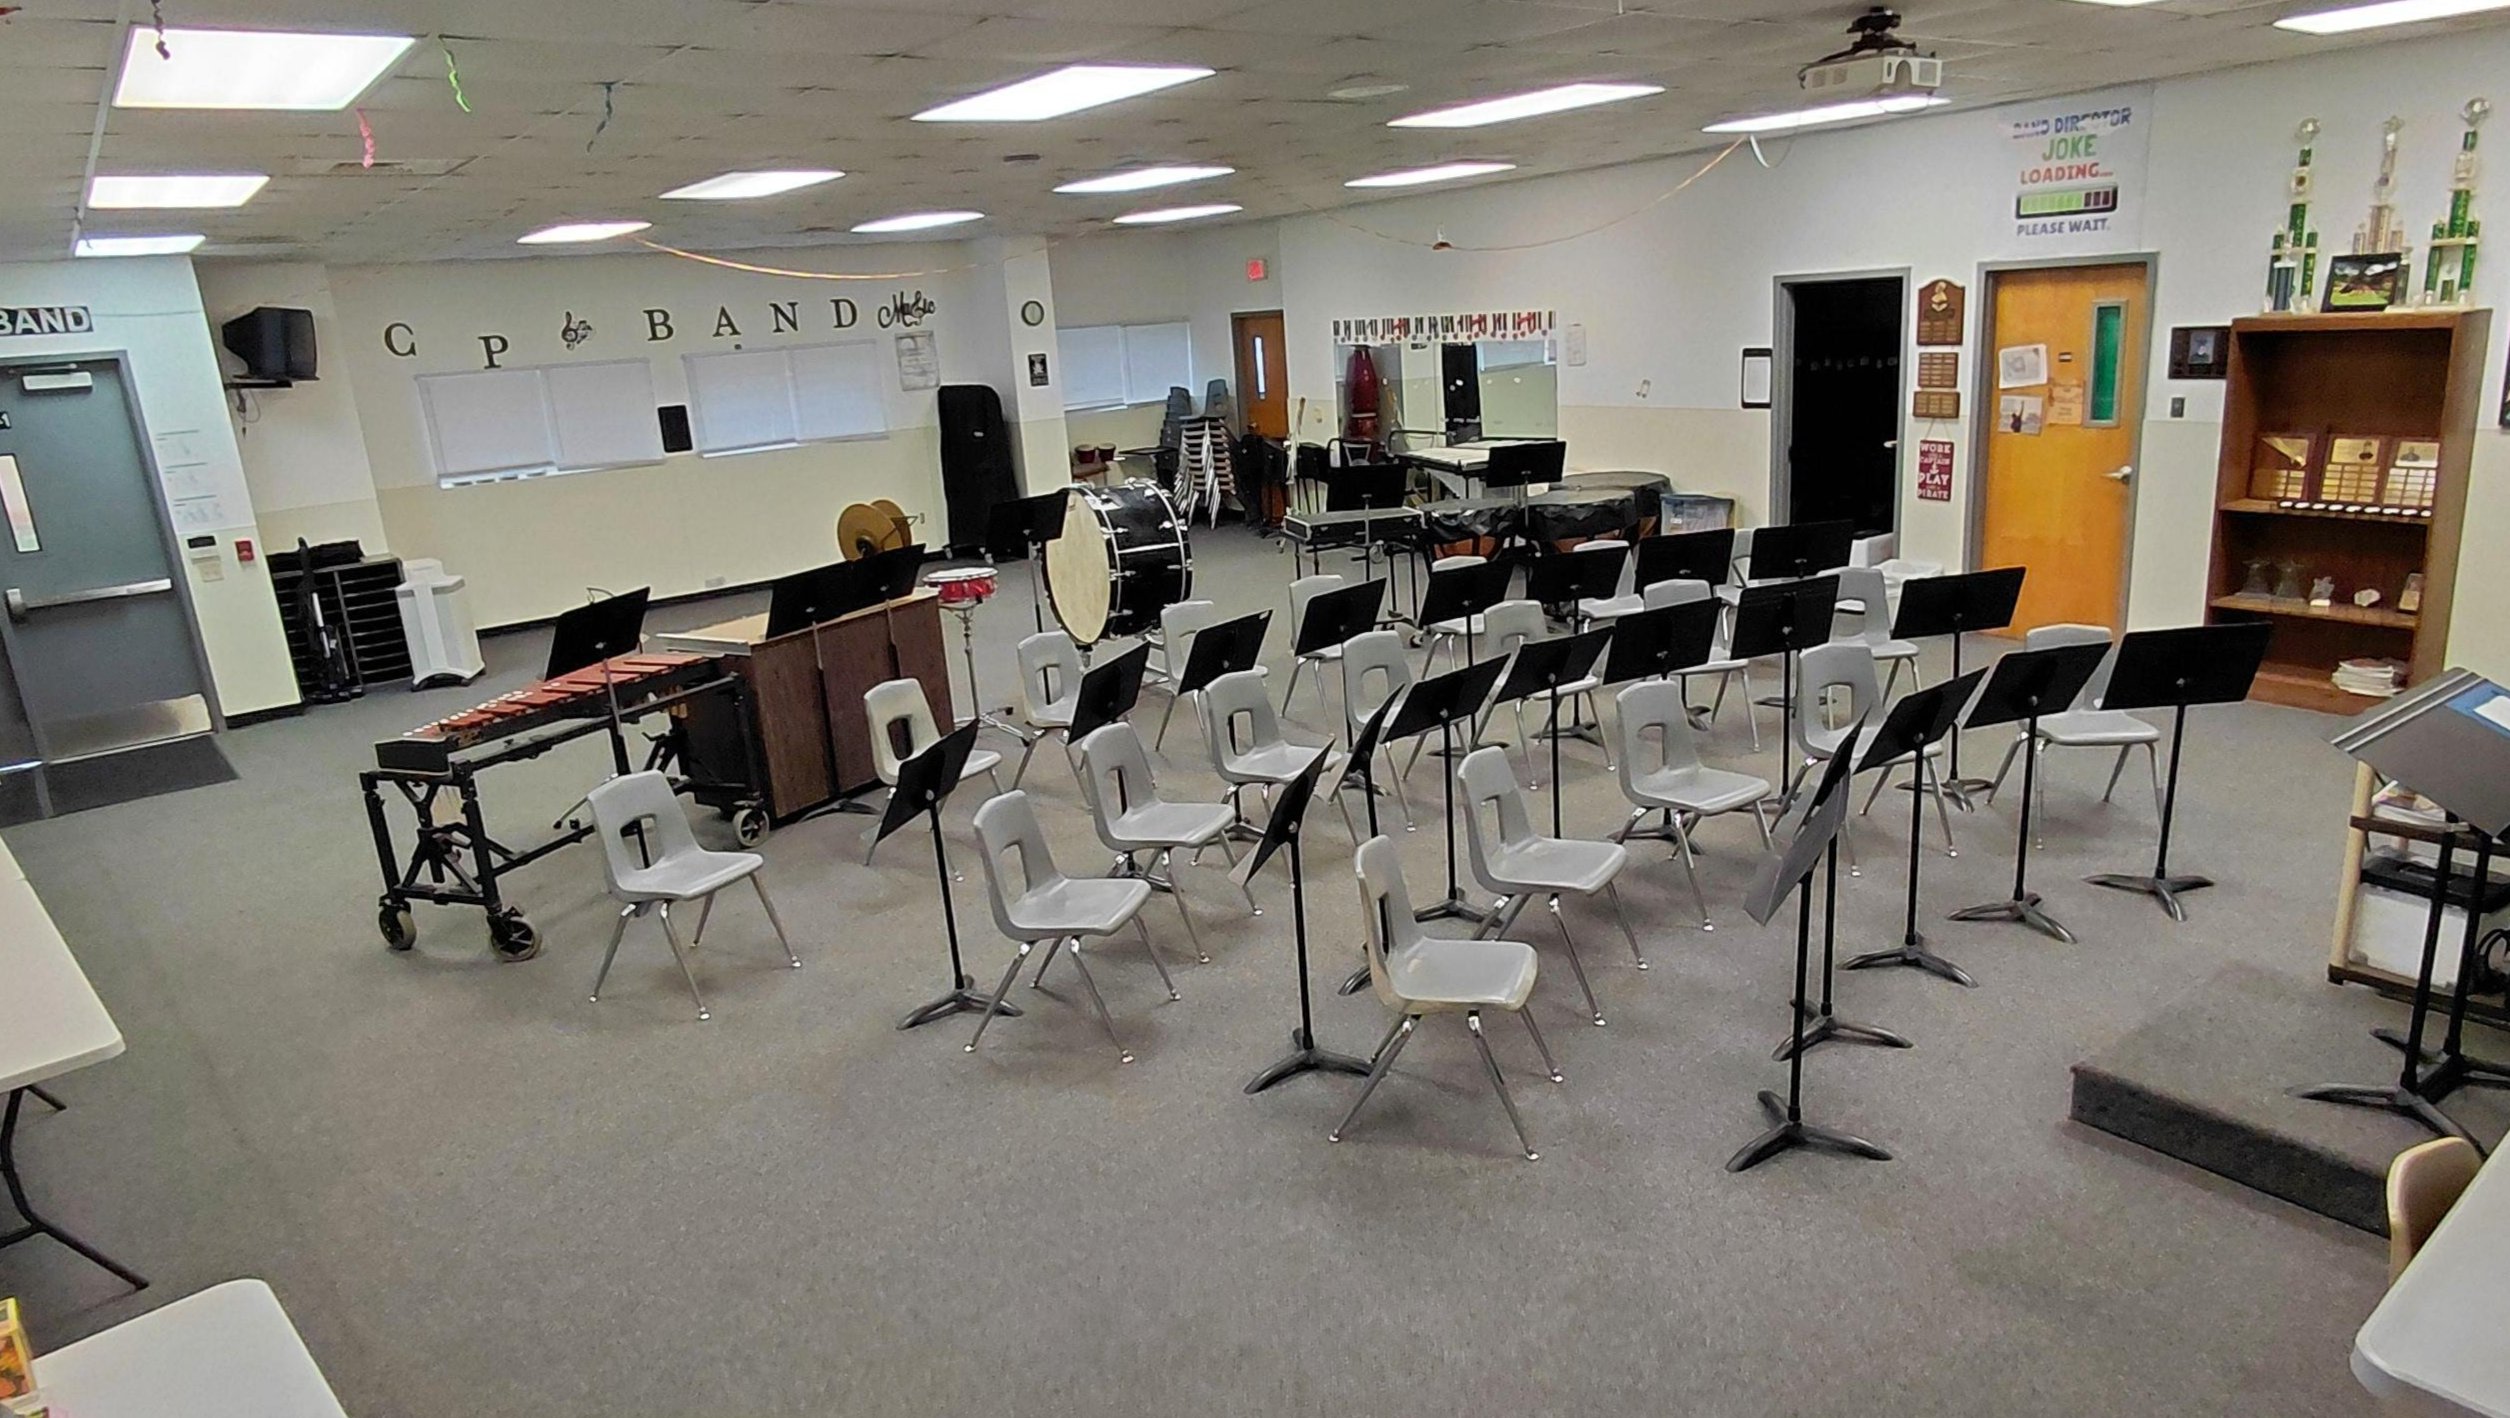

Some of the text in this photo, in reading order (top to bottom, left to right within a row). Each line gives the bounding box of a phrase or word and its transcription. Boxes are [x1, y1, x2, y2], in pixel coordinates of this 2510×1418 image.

[2042, 134, 2098, 161] JOKE
[2017, 221, 2065, 237] PLEASE
[478, 335, 509, 369] P
[1920, 442, 1951, 454] WORK
[1918, 472, 1950, 486] PLAY
